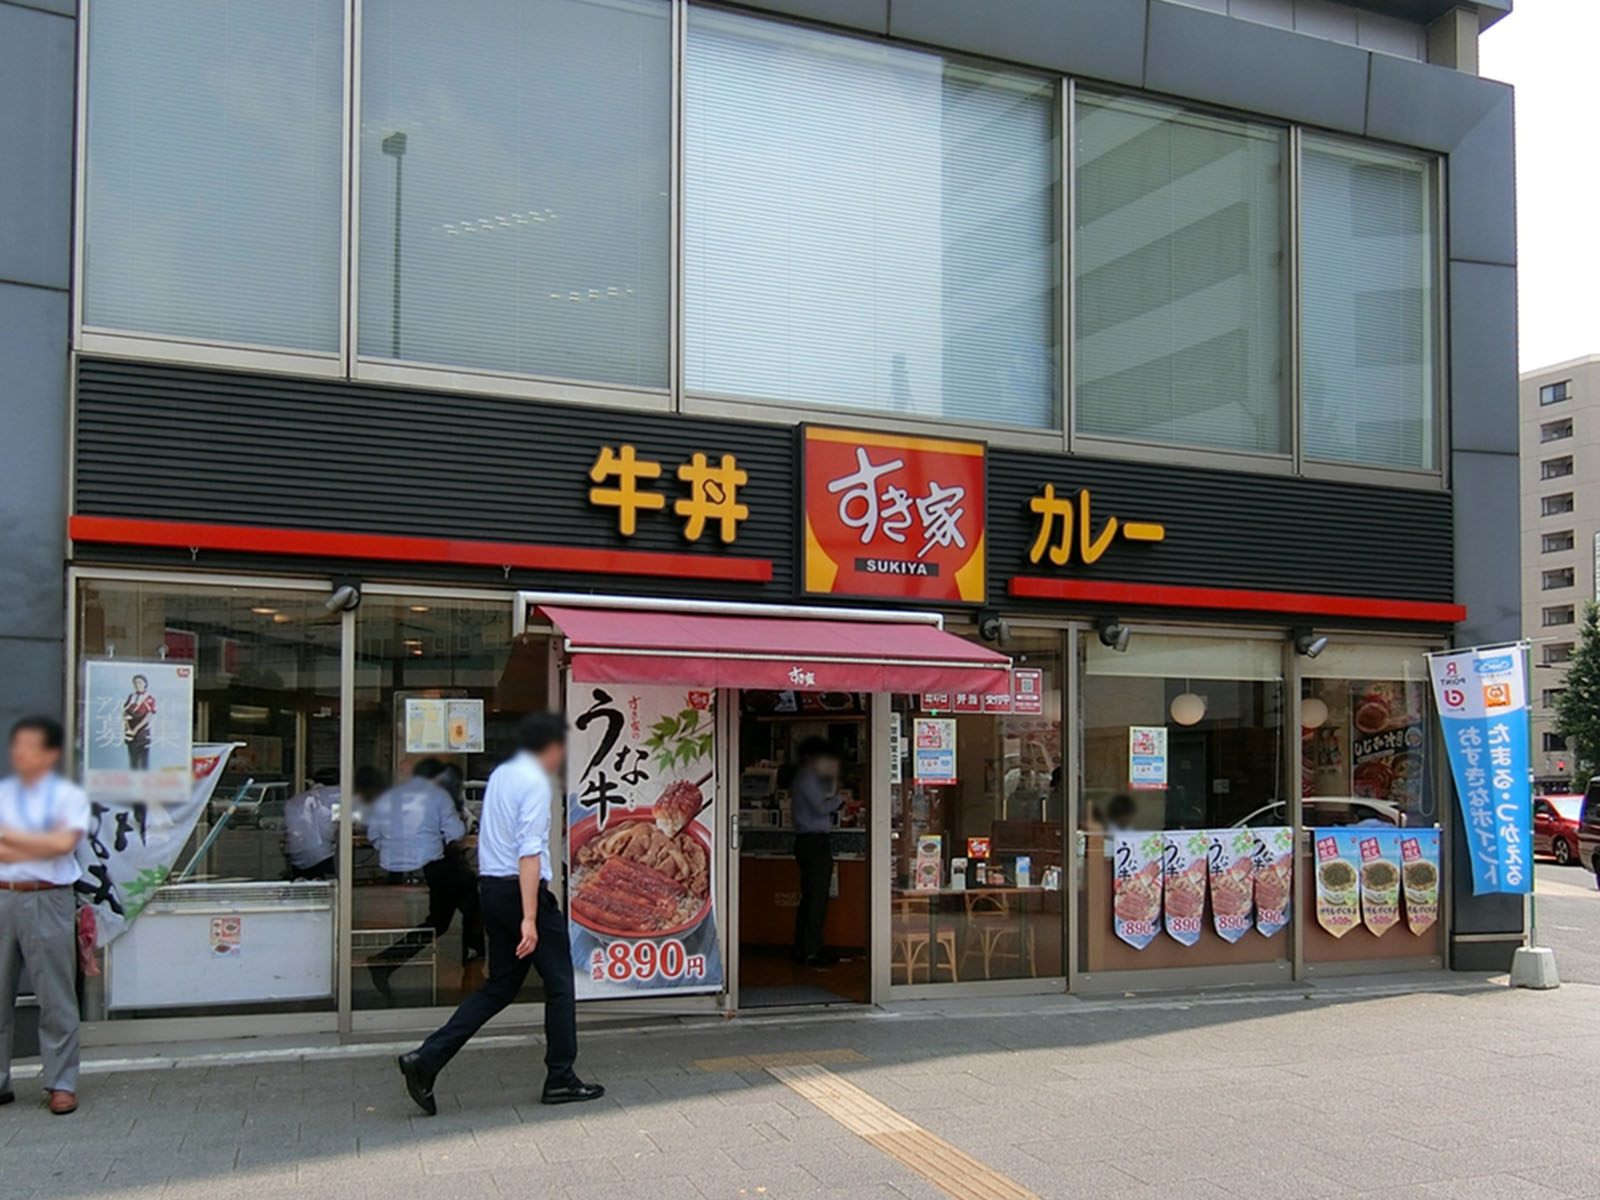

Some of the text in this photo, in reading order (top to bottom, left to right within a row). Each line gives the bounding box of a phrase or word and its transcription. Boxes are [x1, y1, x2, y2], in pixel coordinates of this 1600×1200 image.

[589, 444, 749, 543] 牛丼
[828, 447, 966, 558] すき家
[1030, 483, 1165, 565] カレー
[866, 559, 928, 576] SUKIYA
[607, 940, 705, 981] 890円
